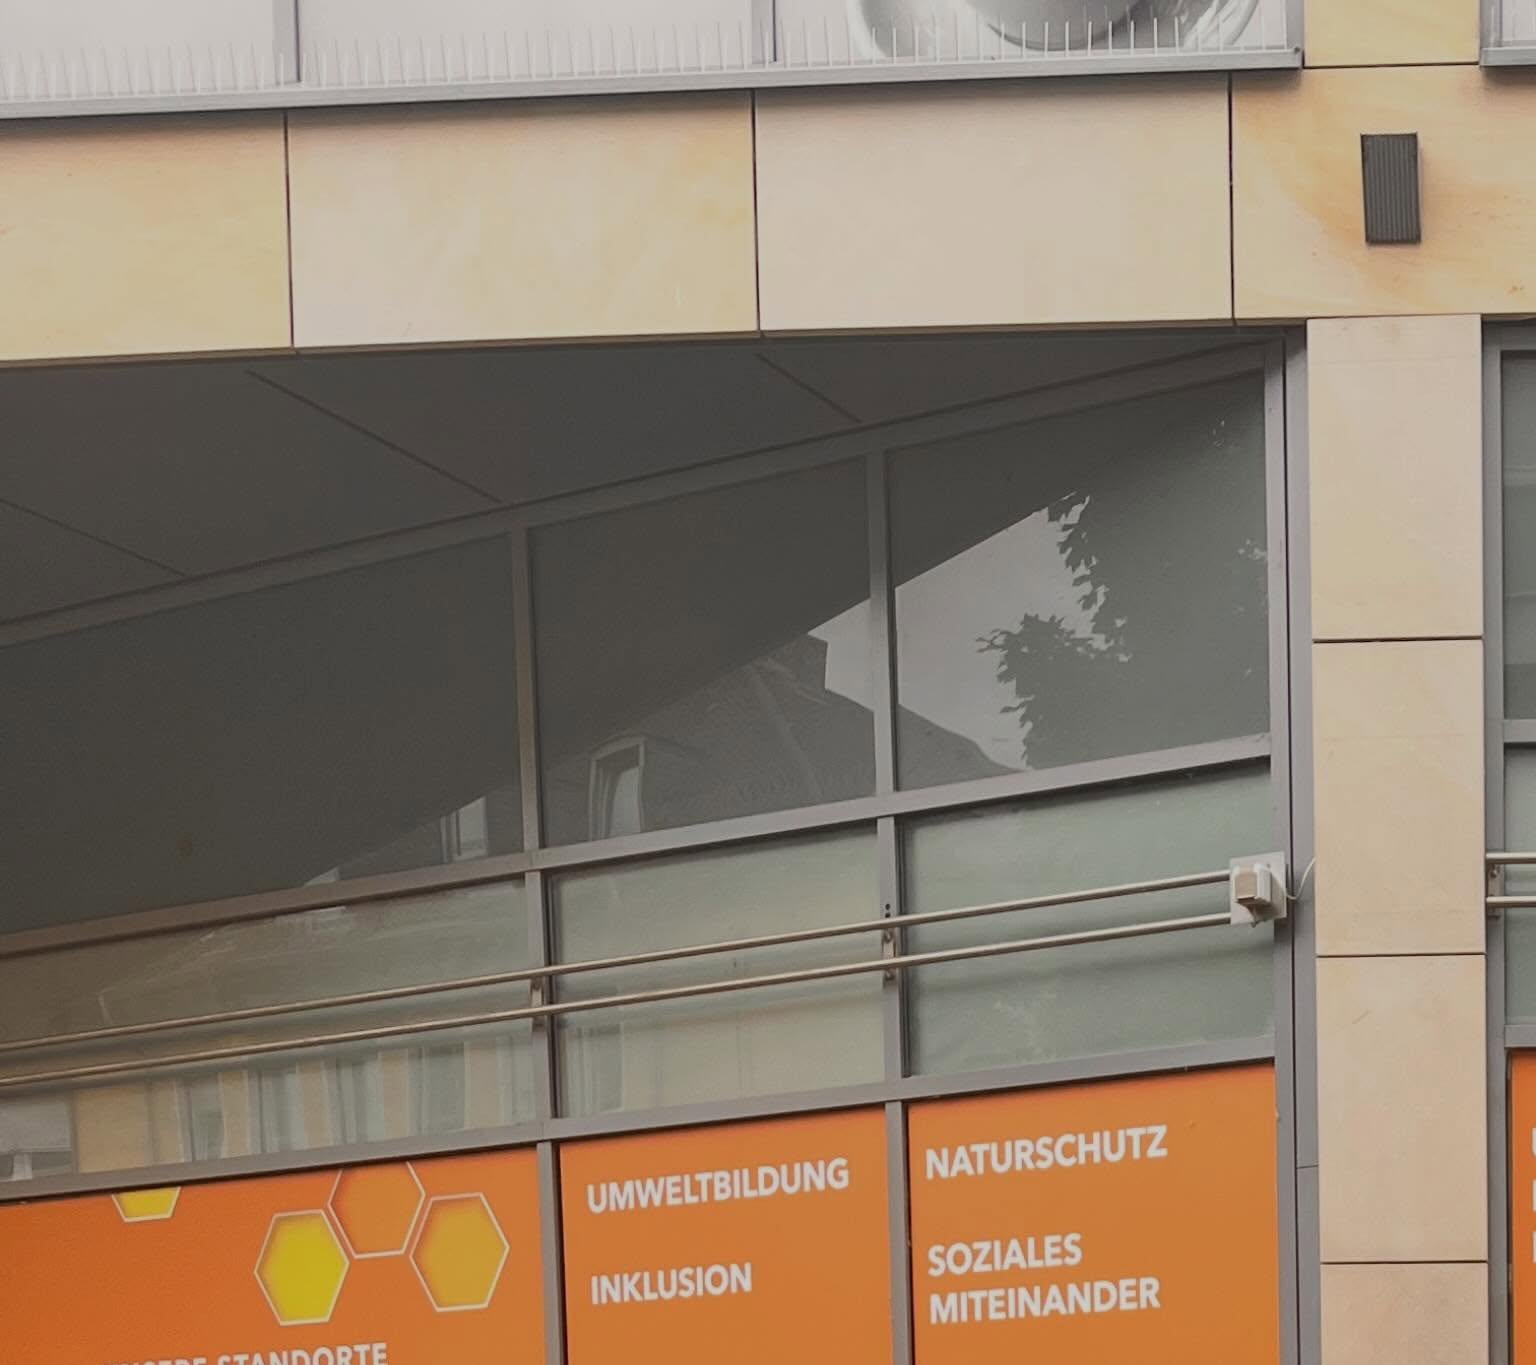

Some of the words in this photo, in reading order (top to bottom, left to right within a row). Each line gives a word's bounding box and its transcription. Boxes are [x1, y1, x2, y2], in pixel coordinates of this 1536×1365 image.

[925, 1124, 1168, 1180] NATURSCHUTZ
[587, 1157, 850, 1214] UMWELTBILDUNG
[928, 1233, 1082, 1278] SOZIALES
[591, 1262, 752, 1305] INKLUSION
[929, 1277, 1160, 1324] MITEINANDER
